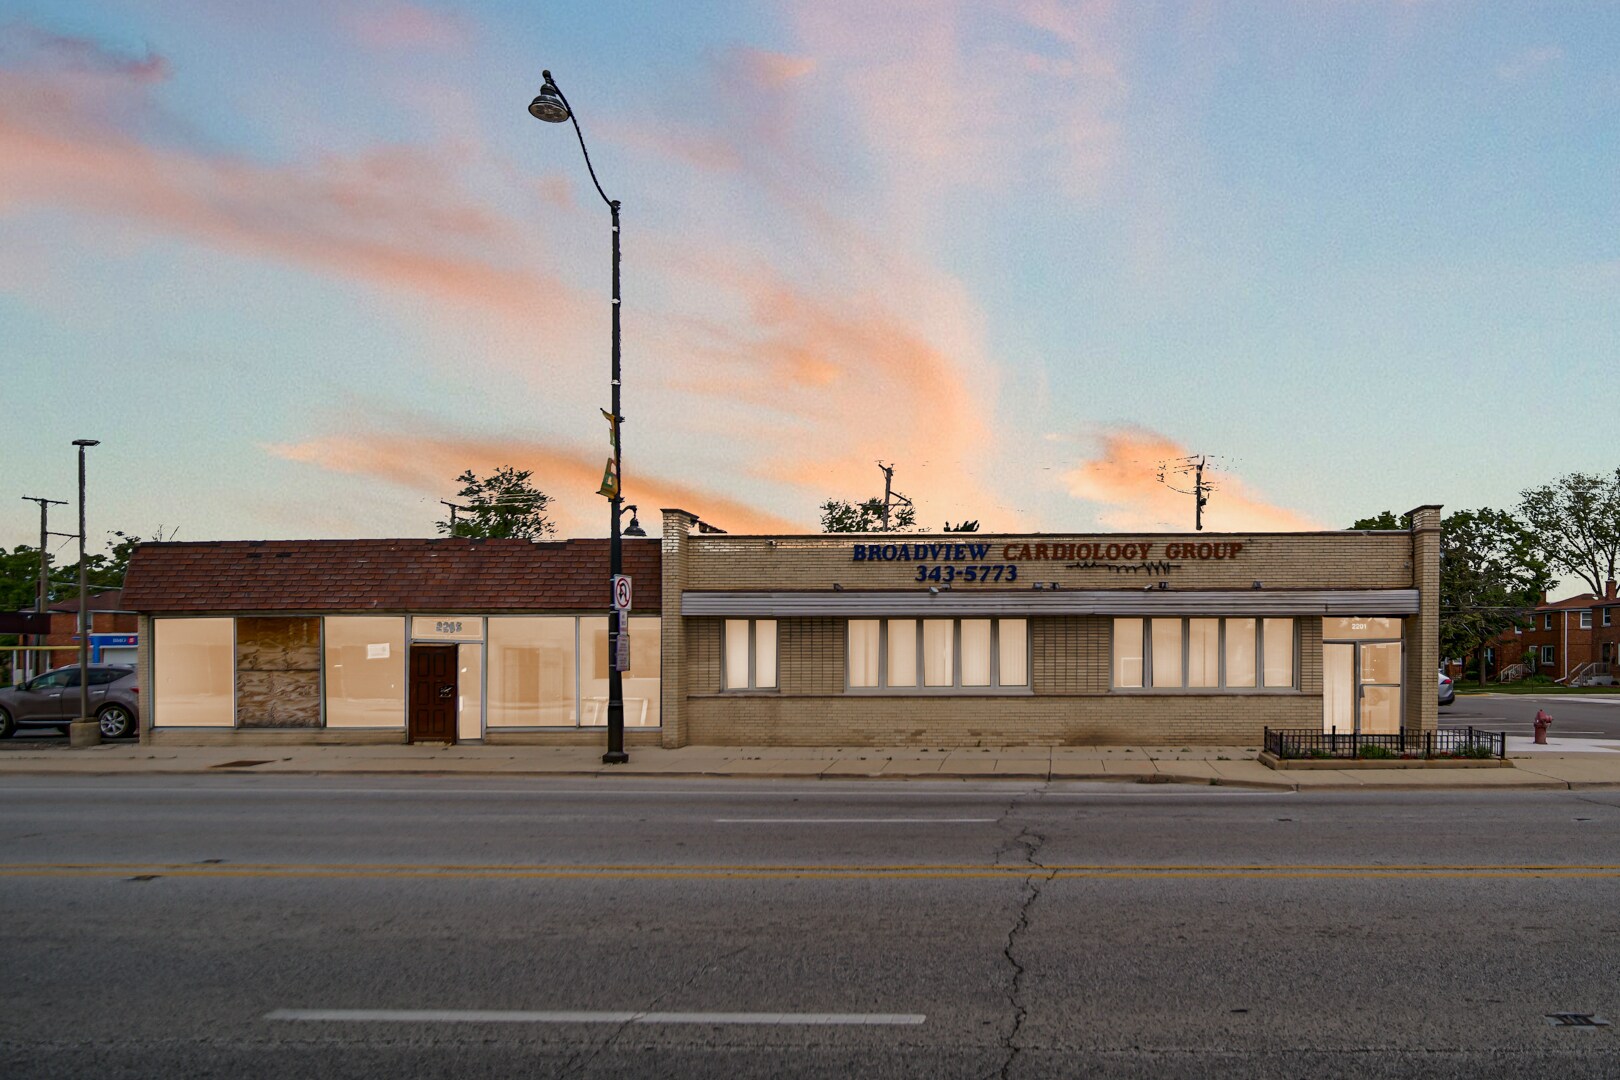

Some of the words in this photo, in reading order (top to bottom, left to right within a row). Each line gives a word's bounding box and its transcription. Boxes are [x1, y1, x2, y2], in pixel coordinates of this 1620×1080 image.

[853, 543, 992, 561] BROADVIEW
[1002, 543, 1153, 561] CARDIOLOGY
[1165, 542, 1243, 559] GROUP
[915, 565, 1018, 582] 343-5773
